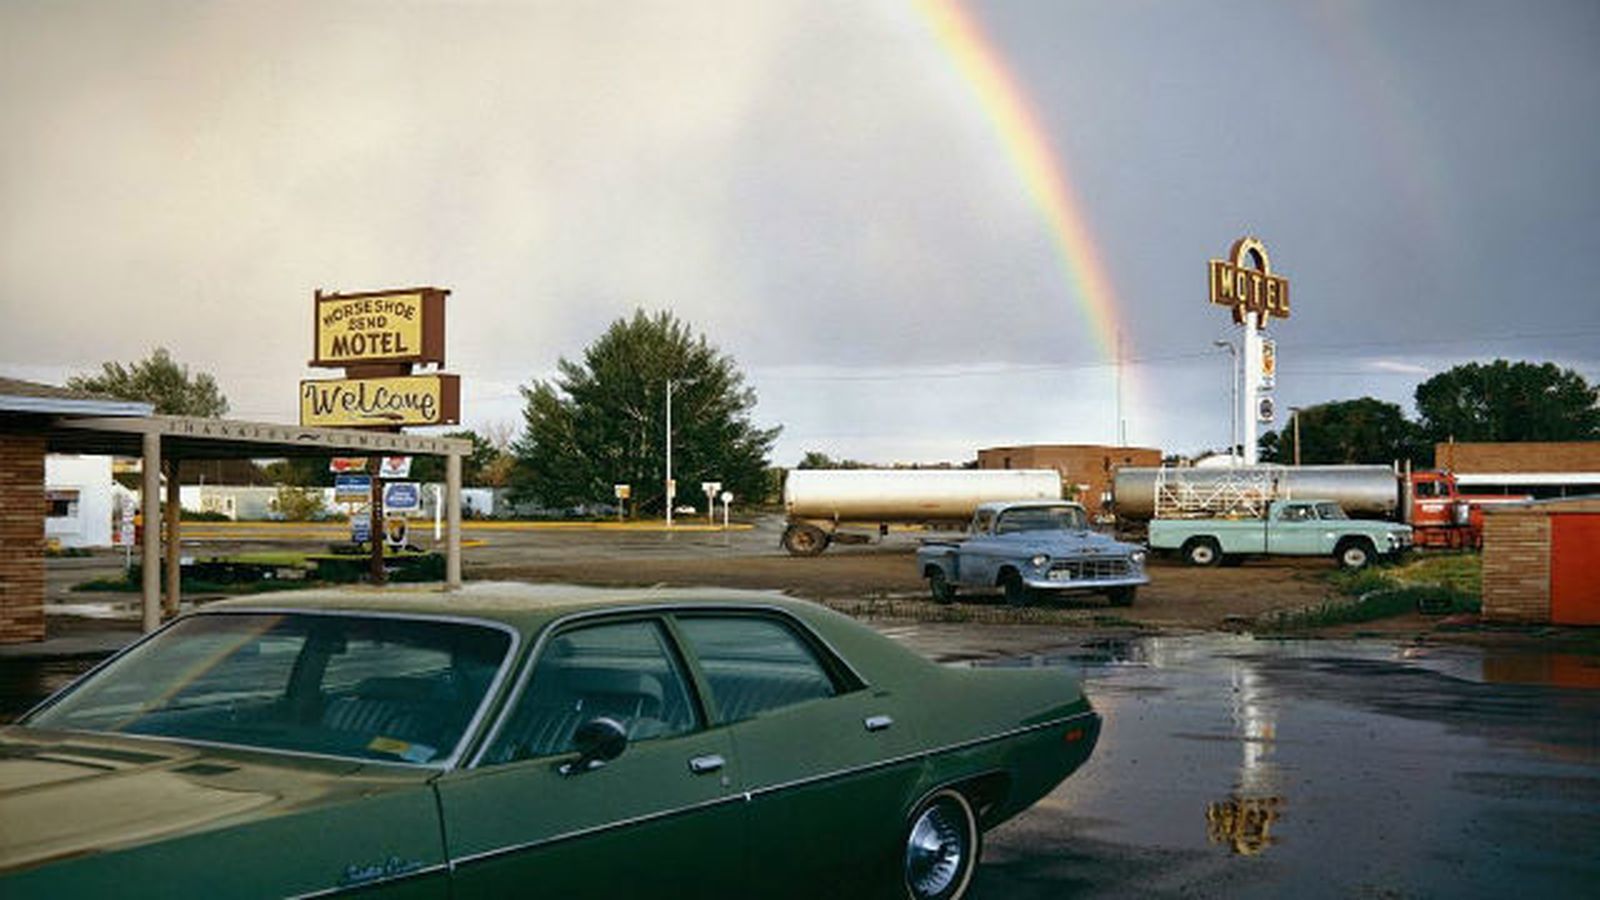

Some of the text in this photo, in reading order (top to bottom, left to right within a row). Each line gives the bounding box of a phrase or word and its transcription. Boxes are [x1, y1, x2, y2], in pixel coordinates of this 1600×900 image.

[1221, 266, 1289, 311] MOTEL
[324, 300, 416, 327] HORSESHOE
[331, 332, 408, 357] MOTEL
[305, 382, 436, 420] Welcome
